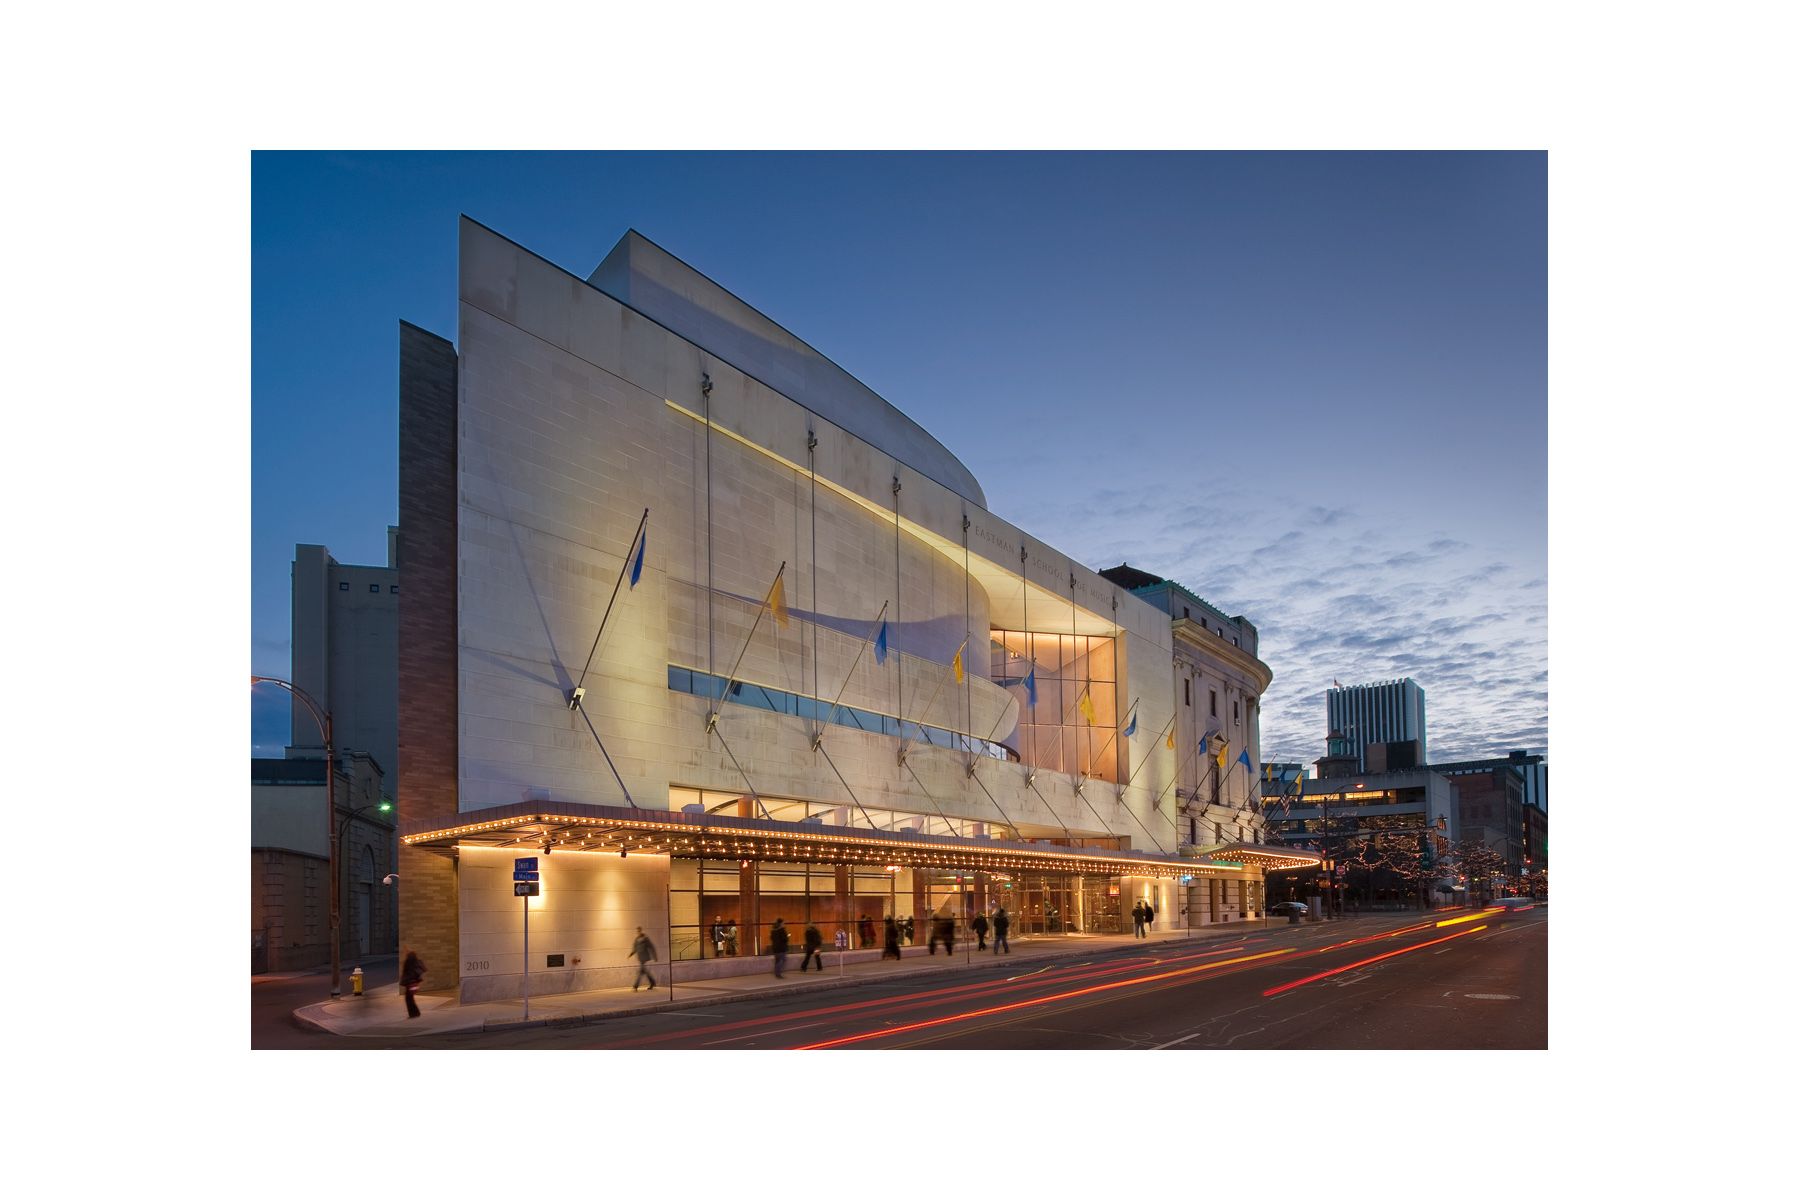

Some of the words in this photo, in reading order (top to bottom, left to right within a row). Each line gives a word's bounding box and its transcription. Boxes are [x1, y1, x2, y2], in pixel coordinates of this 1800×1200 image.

[975, 525, 1015, 554] EASTMAN
[1032, 556, 1064, 582] SCHOOL
[466, 960, 490, 971] 2010
